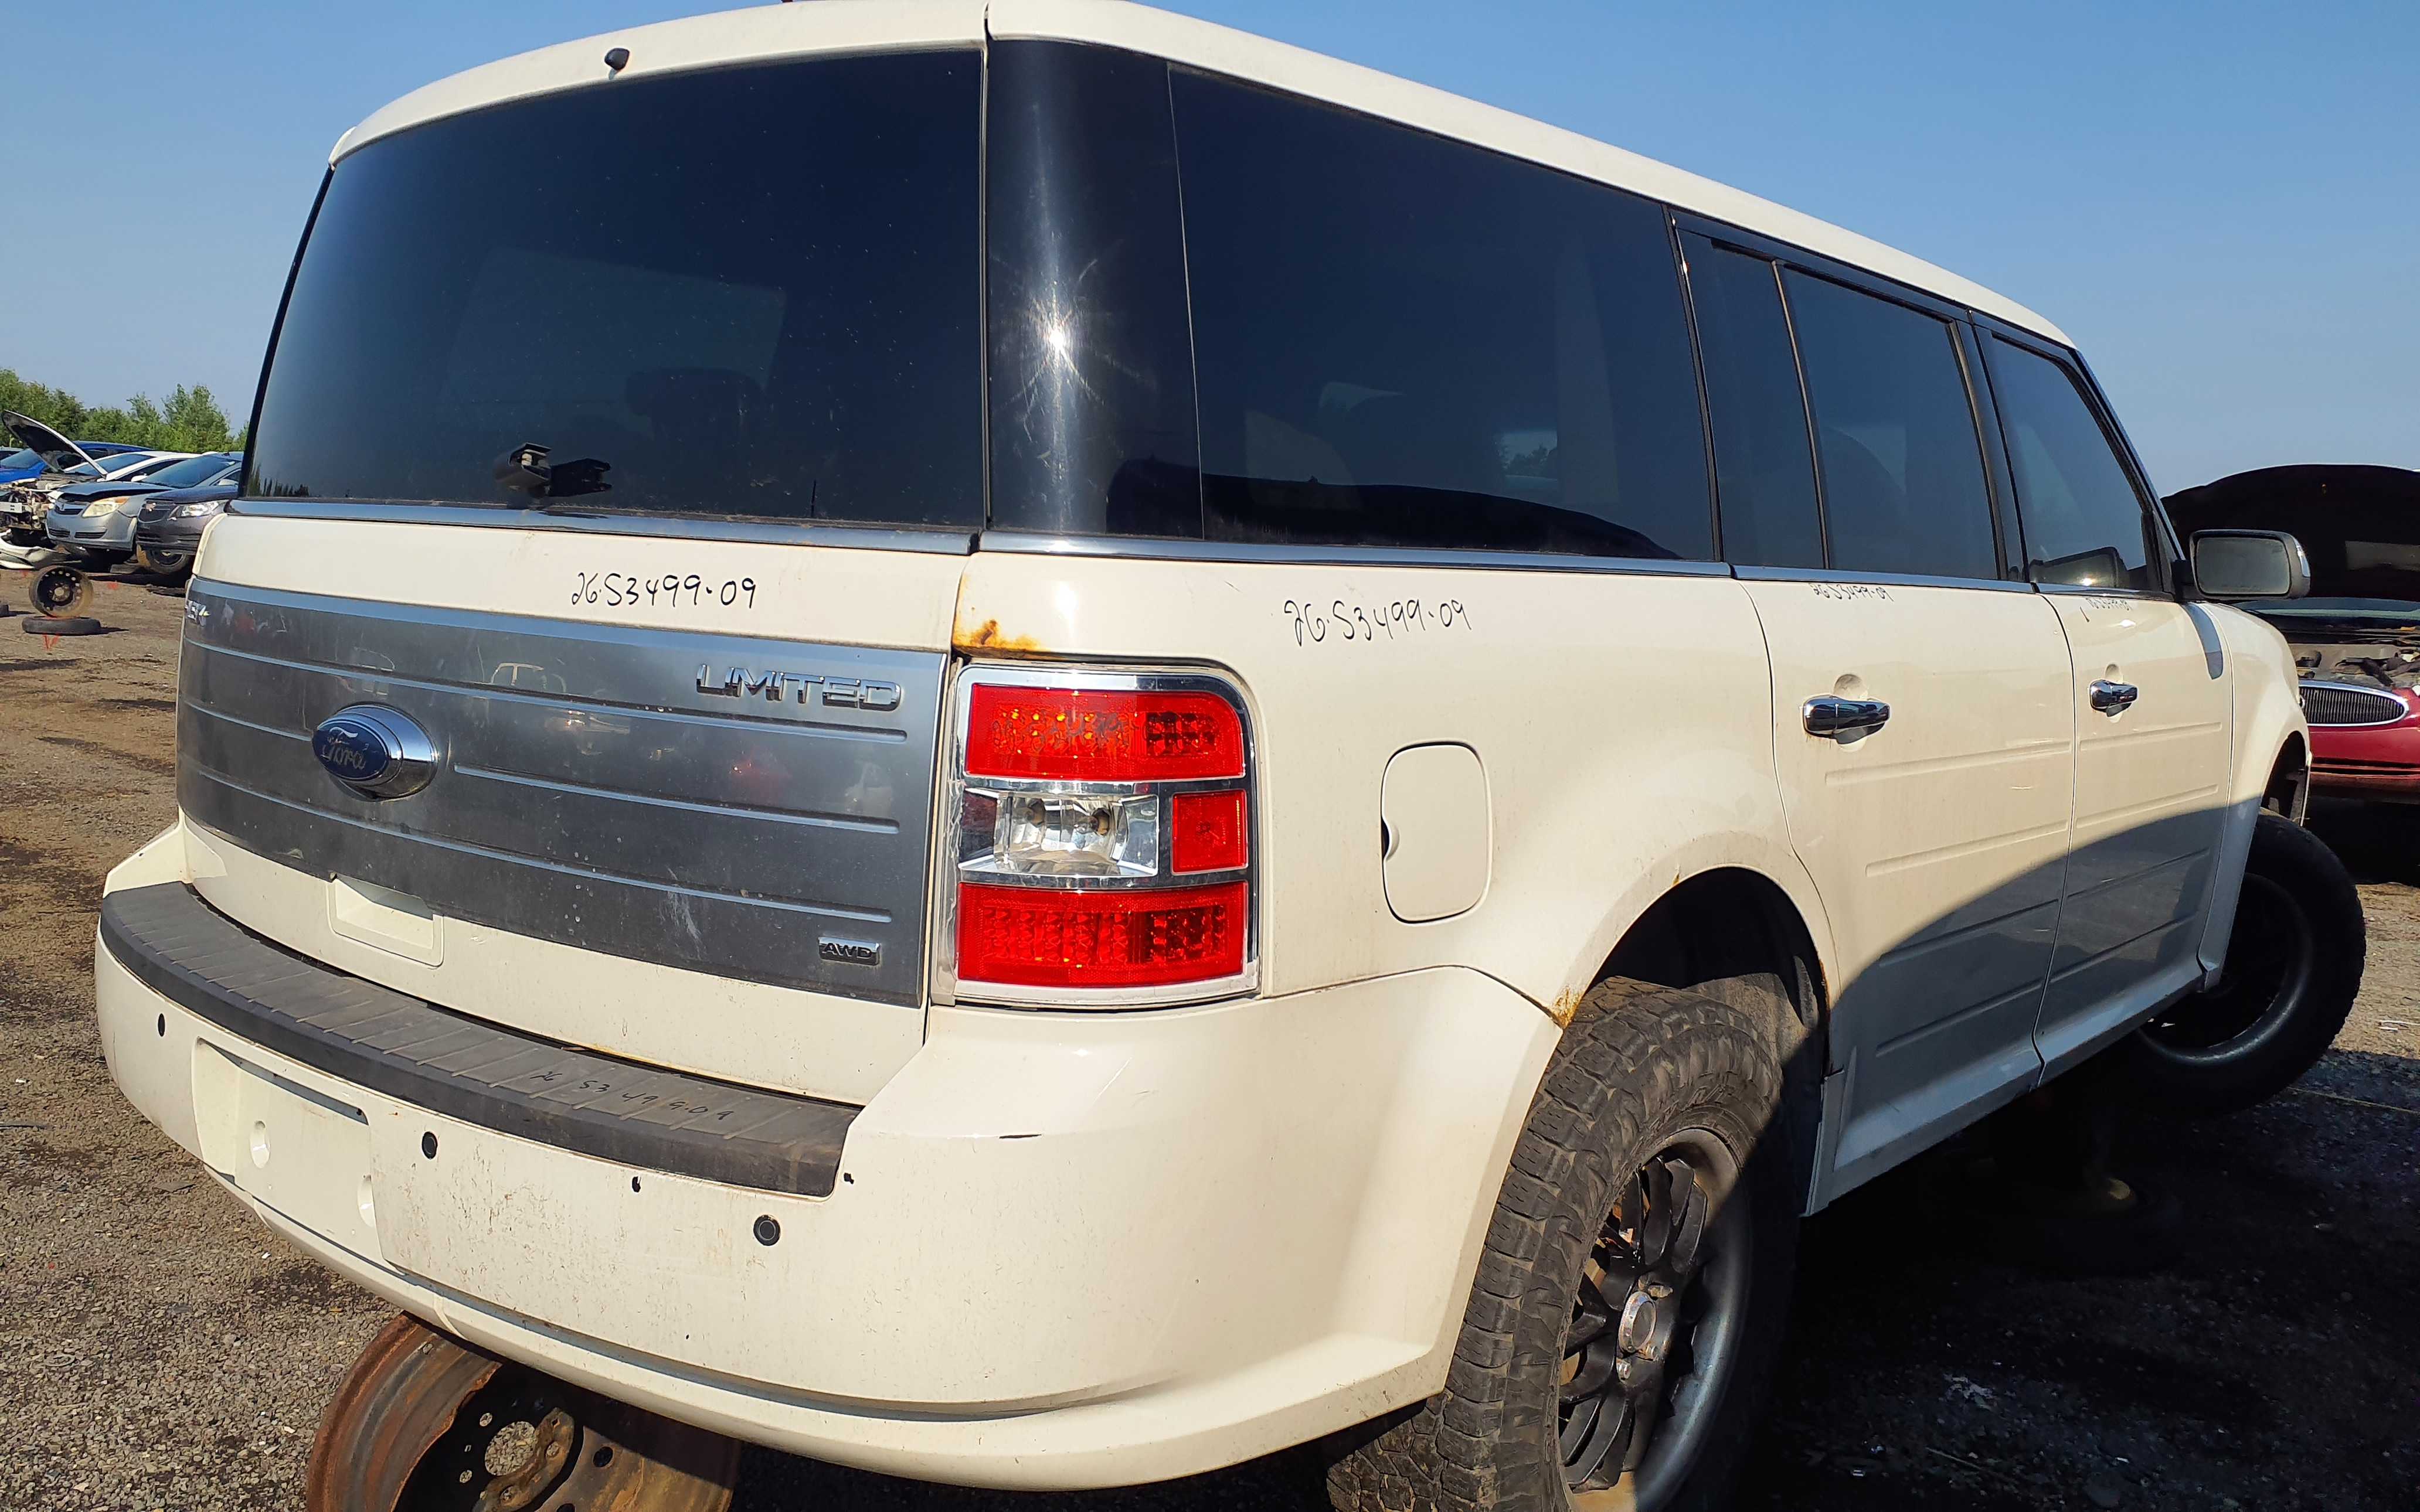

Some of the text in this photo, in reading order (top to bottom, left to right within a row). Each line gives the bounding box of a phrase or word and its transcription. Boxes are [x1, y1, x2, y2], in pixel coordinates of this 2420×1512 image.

[696, 664, 902, 711] LIMITED
[321, 726, 369, 769] Ford
[820, 942, 873, 959] AWD
